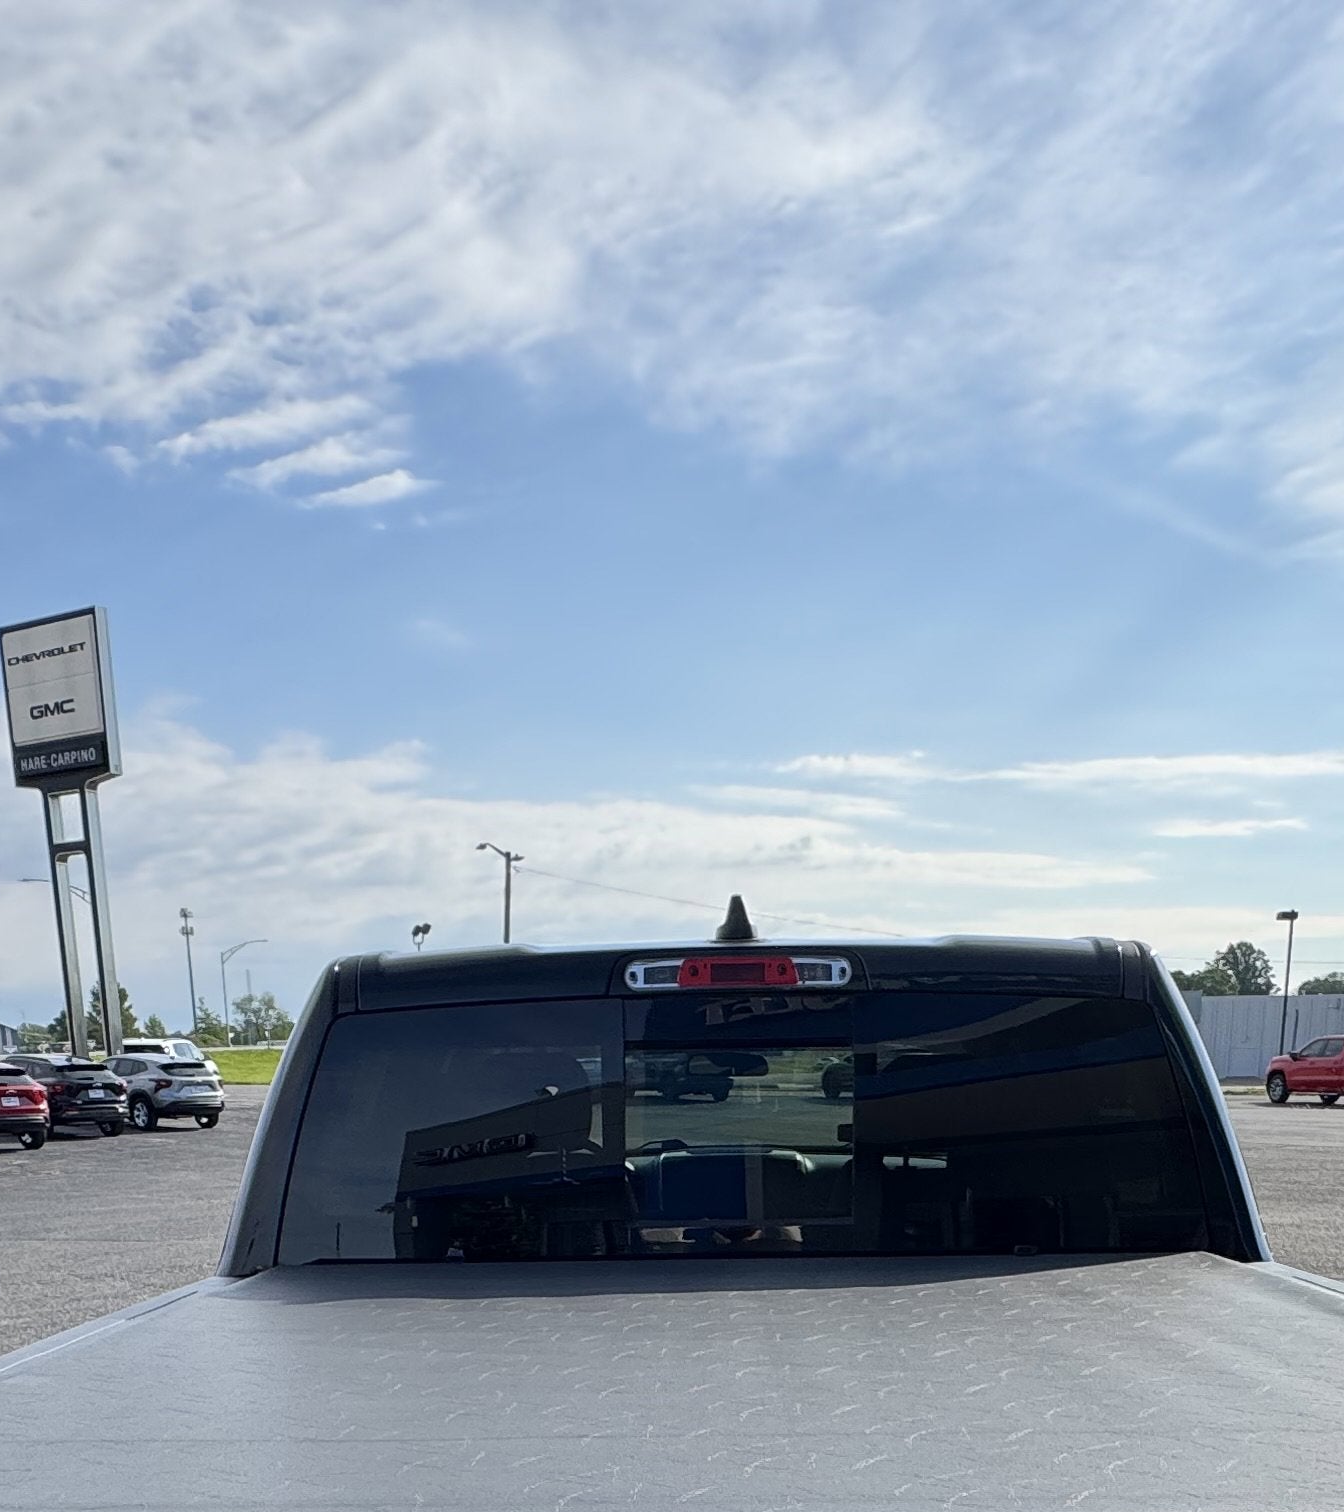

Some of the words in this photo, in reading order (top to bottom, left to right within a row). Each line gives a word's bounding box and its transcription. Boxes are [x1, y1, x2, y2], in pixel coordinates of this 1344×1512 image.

[7, 642, 86, 666] CHEVROLET
[30, 699, 75, 720] GMC
[20, 748, 96, 772] HARE-CARPINO
